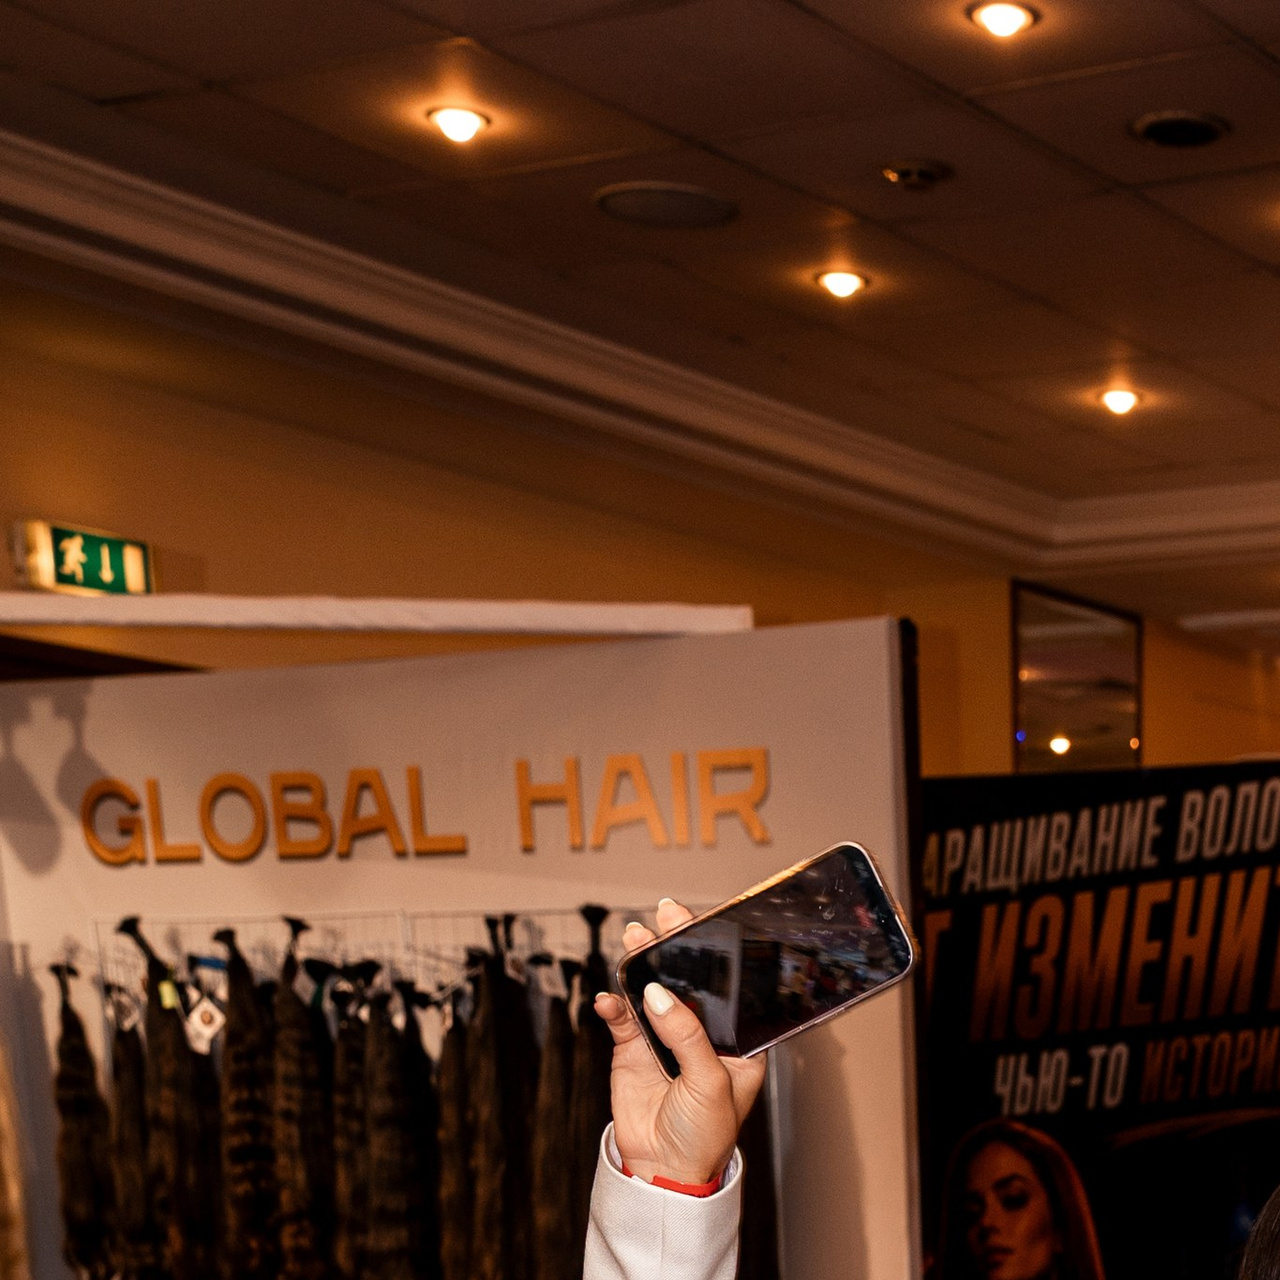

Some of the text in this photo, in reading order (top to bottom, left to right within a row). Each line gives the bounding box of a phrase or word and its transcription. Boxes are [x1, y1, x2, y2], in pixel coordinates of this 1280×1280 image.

[82, 747, 771, 867] GLOBAL HAIR
[922, 795, 1167, 897] АРАЩИВАНИЕ
[993, 1042, 1129, 1116] ЧЬЮ-ТО
